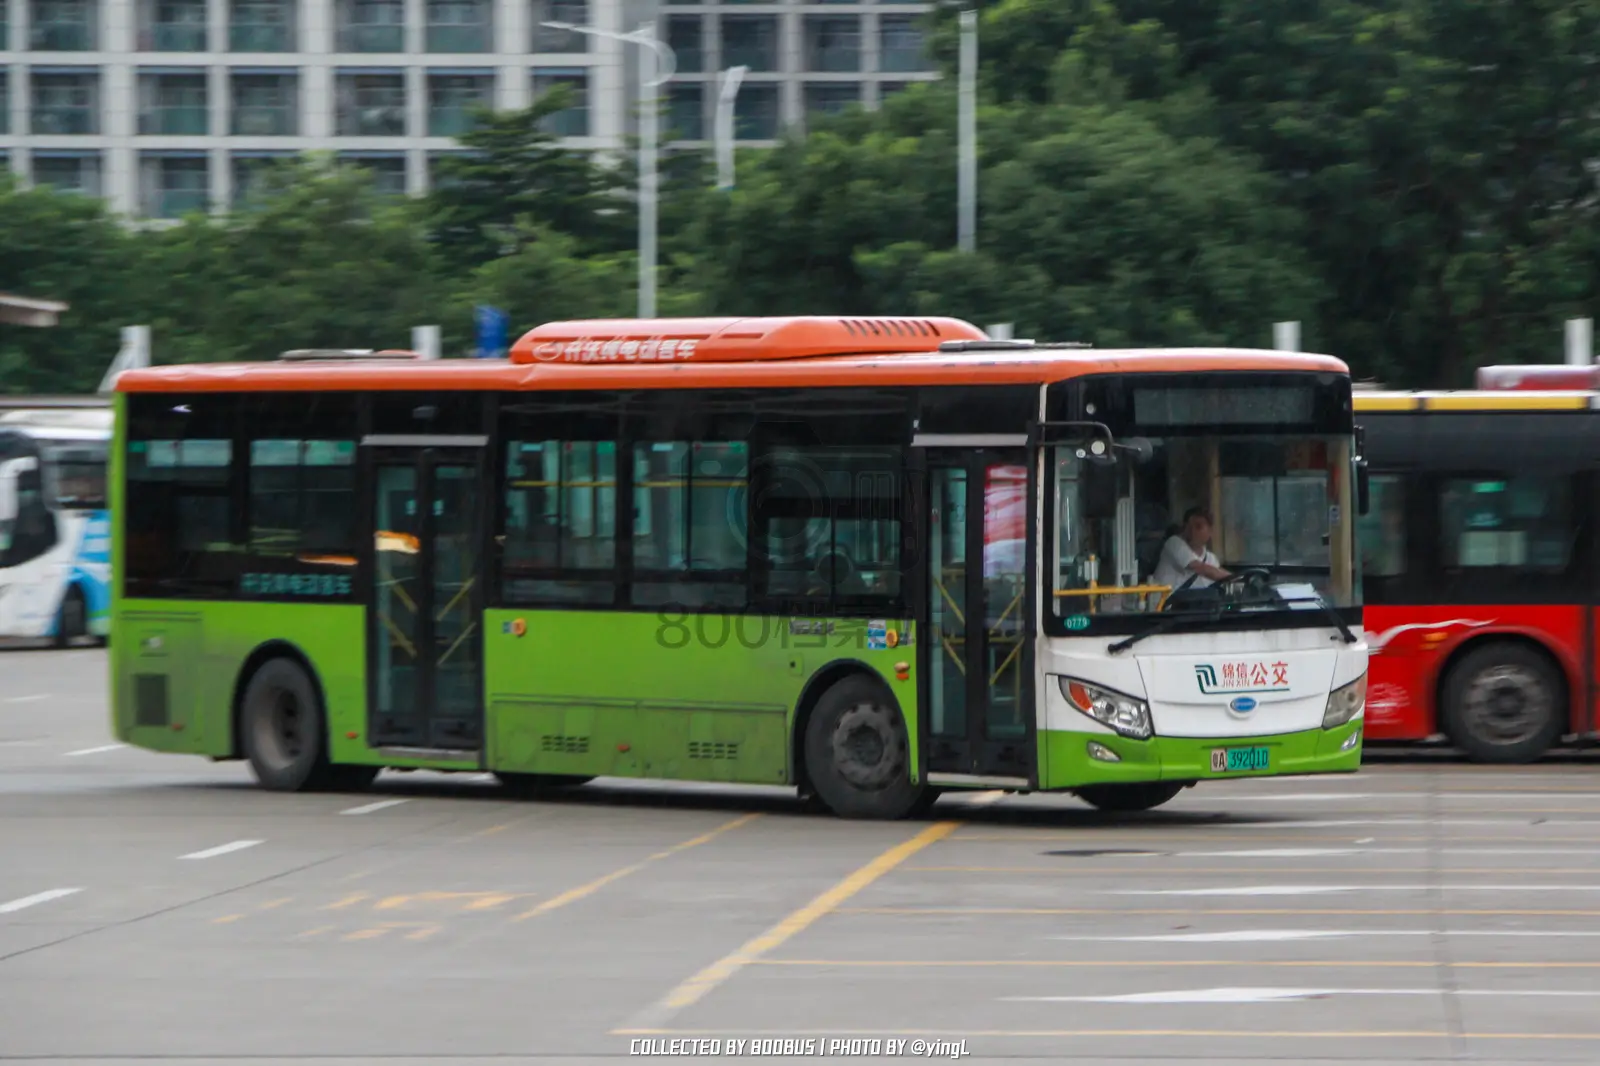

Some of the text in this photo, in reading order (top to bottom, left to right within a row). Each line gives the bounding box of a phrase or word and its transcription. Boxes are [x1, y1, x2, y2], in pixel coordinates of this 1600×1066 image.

[1066, 616, 1088, 629] 0779
[1222, 660, 1289, 686] 锦信公交
[1222, 679, 1250, 688] JIN XIN
[1230, 749, 1268, 768] 39201D
